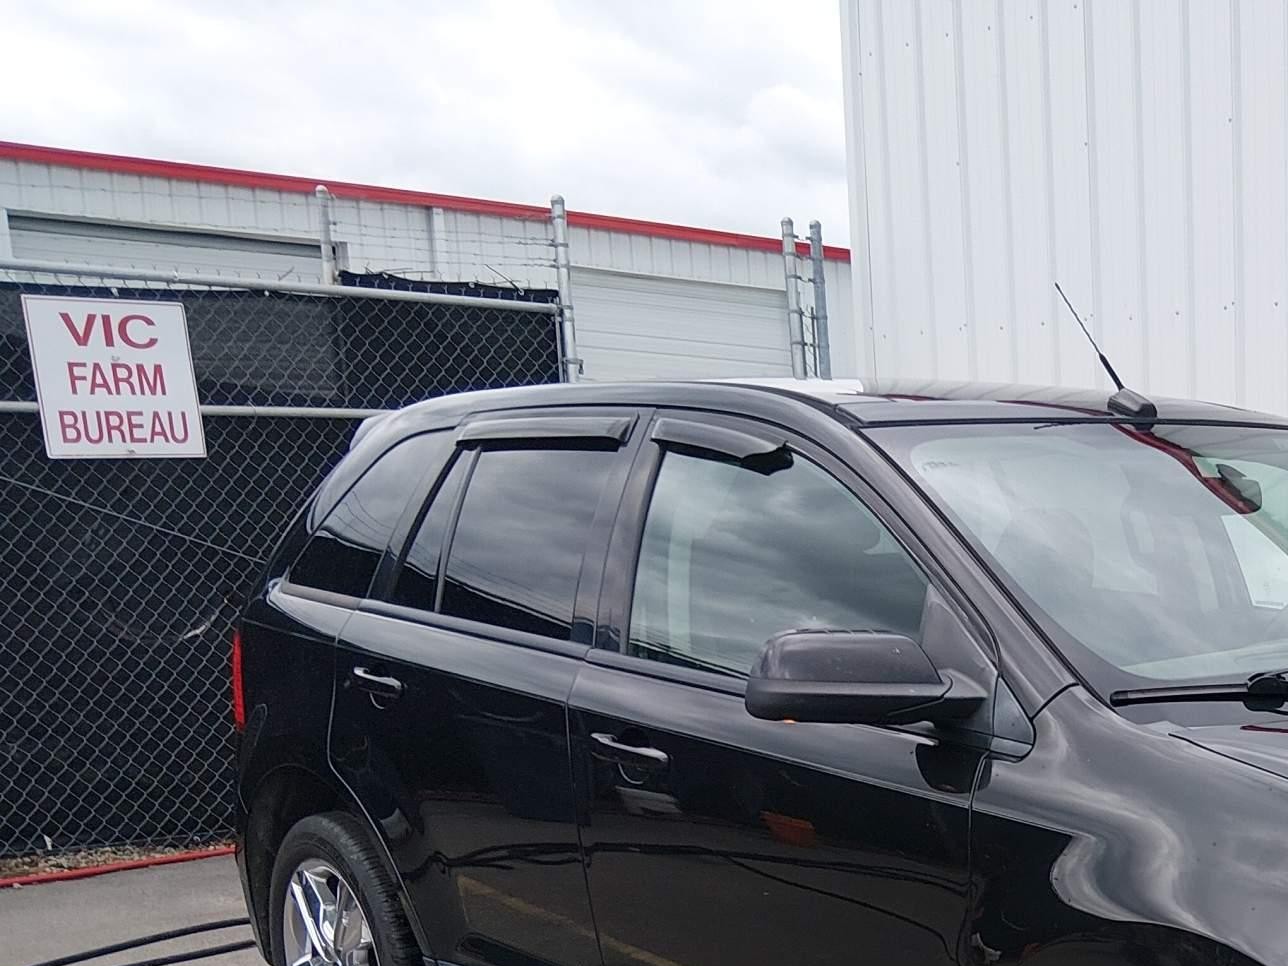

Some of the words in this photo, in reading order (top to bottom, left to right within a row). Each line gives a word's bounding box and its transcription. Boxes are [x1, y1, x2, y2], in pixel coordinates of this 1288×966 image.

[59, 312, 158, 349] VIC
[67, 362, 167, 396] FARM
[58, 410, 189, 444] BUREAU
